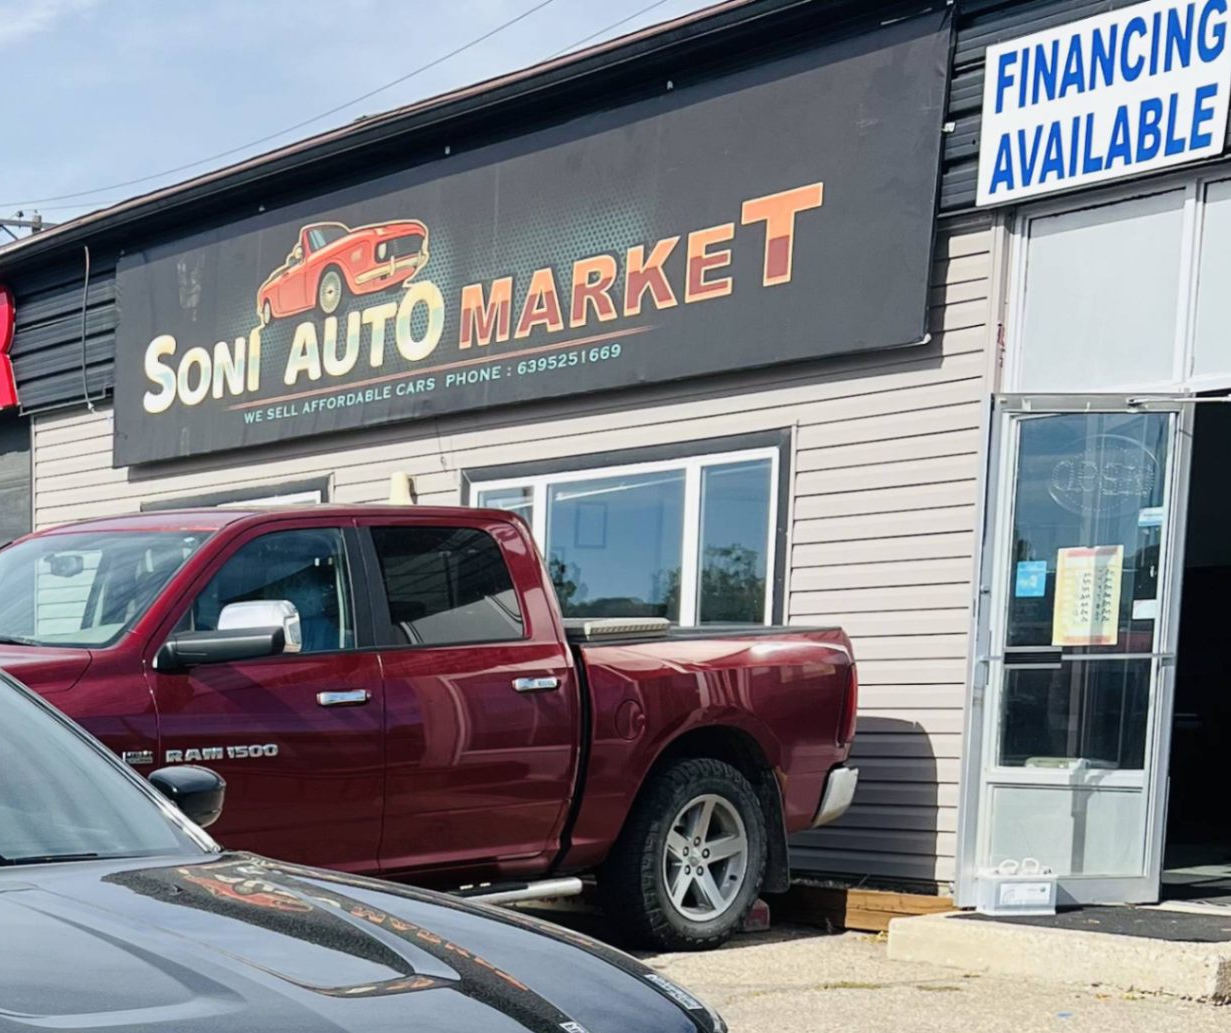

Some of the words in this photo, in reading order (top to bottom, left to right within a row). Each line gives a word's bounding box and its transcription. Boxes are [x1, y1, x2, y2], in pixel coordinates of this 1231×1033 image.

[994, 0, 1229, 114] FINANCING
[988, 82, 1219, 195] AVAILABLE
[282, 279, 446, 386] AUTO
[458, 181, 824, 350] MARKET
[244, 409, 263, 425] WE
[267, 405, 298, 420] SELL
[301, 385, 392, 415] AFFORDABLE
[395, 377, 436, 397] CARS
[445, 366, 502, 388] PHONE
[516, 343, 622, 375] 6395251669
[165, 747, 224, 763] RAM
[226, 743, 279, 759] 1500
